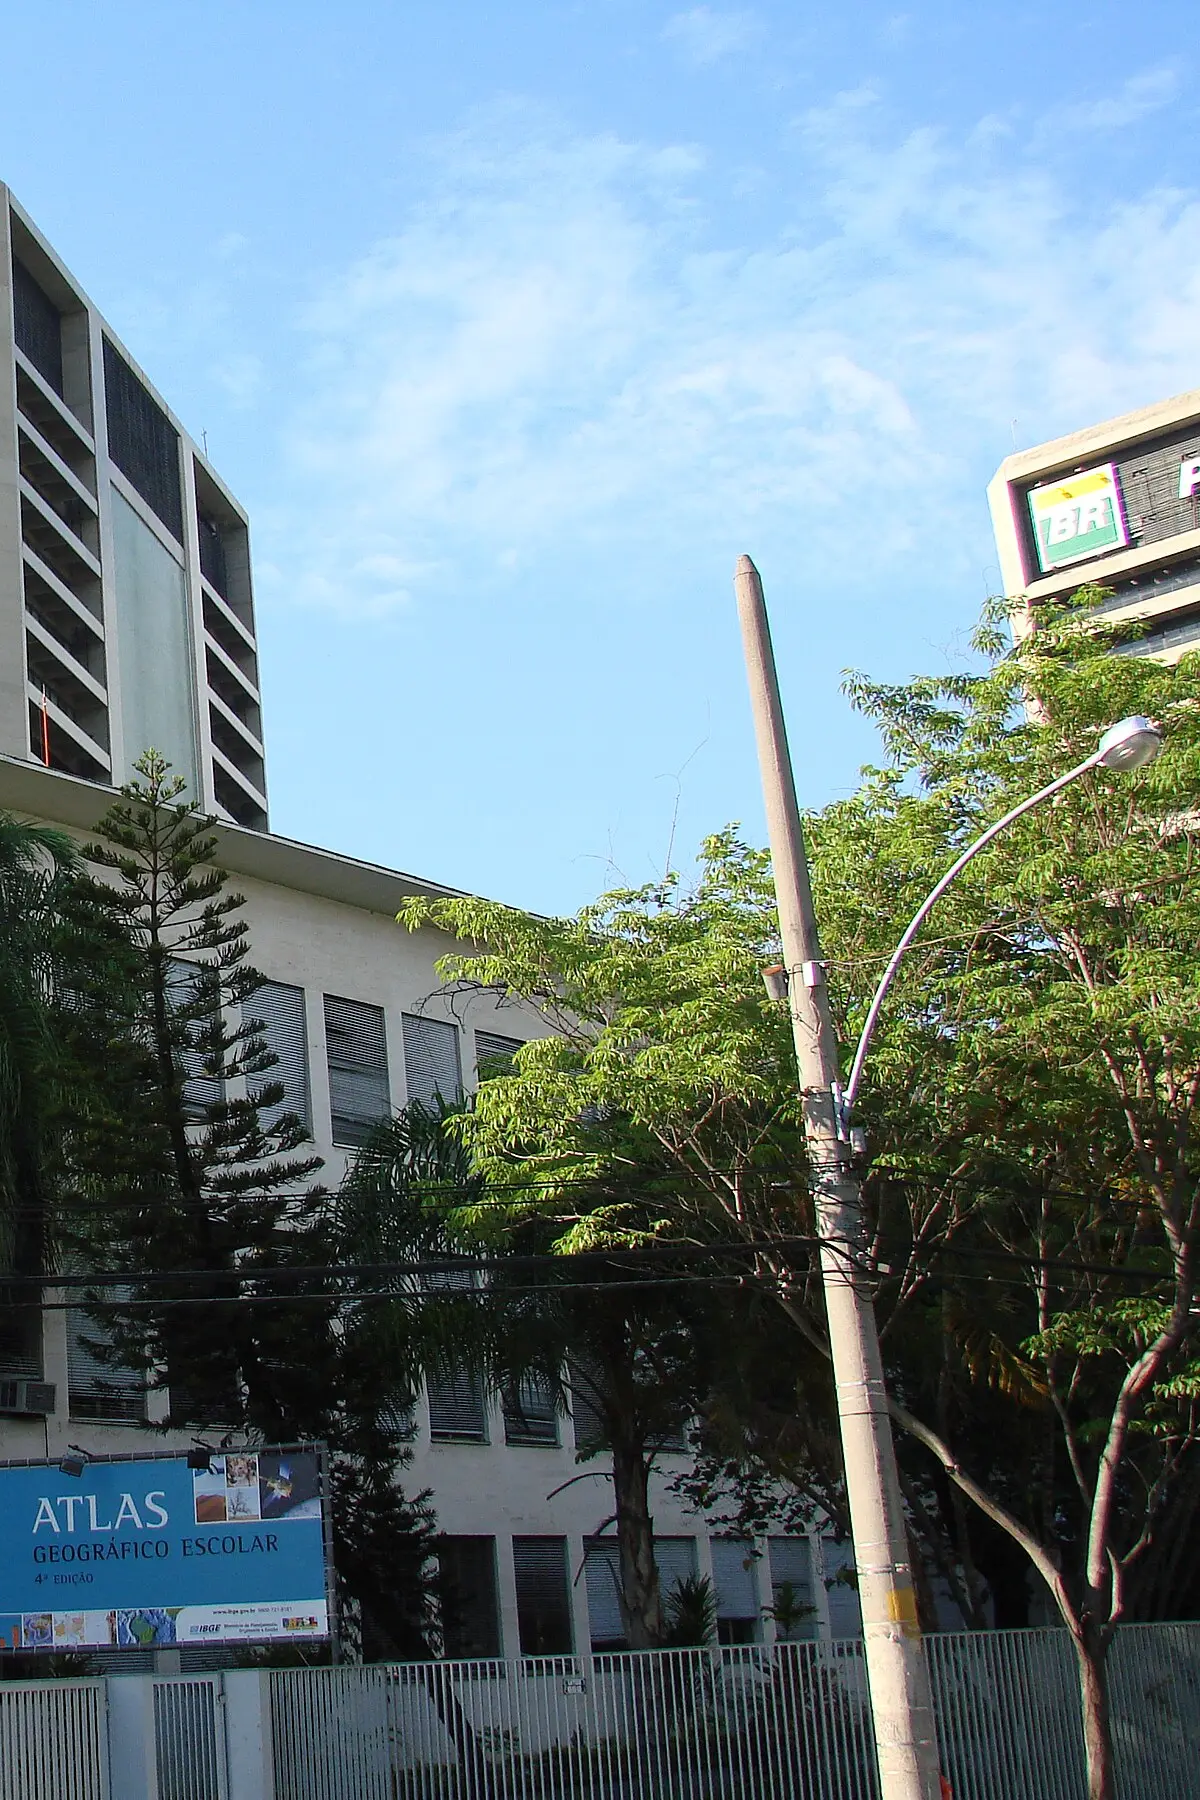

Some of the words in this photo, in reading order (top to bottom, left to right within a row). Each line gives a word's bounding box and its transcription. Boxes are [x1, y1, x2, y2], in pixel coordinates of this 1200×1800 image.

[1047, 499, 1109, 545] BR
[32, 1491, 169, 1534] ATLAS
[33, 1537, 169, 1564] GEOGRÁFICO
[181, 1534, 279, 1557] ESCOLAR
[35, 1573, 49, 1585] 4ª
[54, 1572, 94, 1587] EDIÇÃO
[199, 1624, 221, 1633] IBGE
